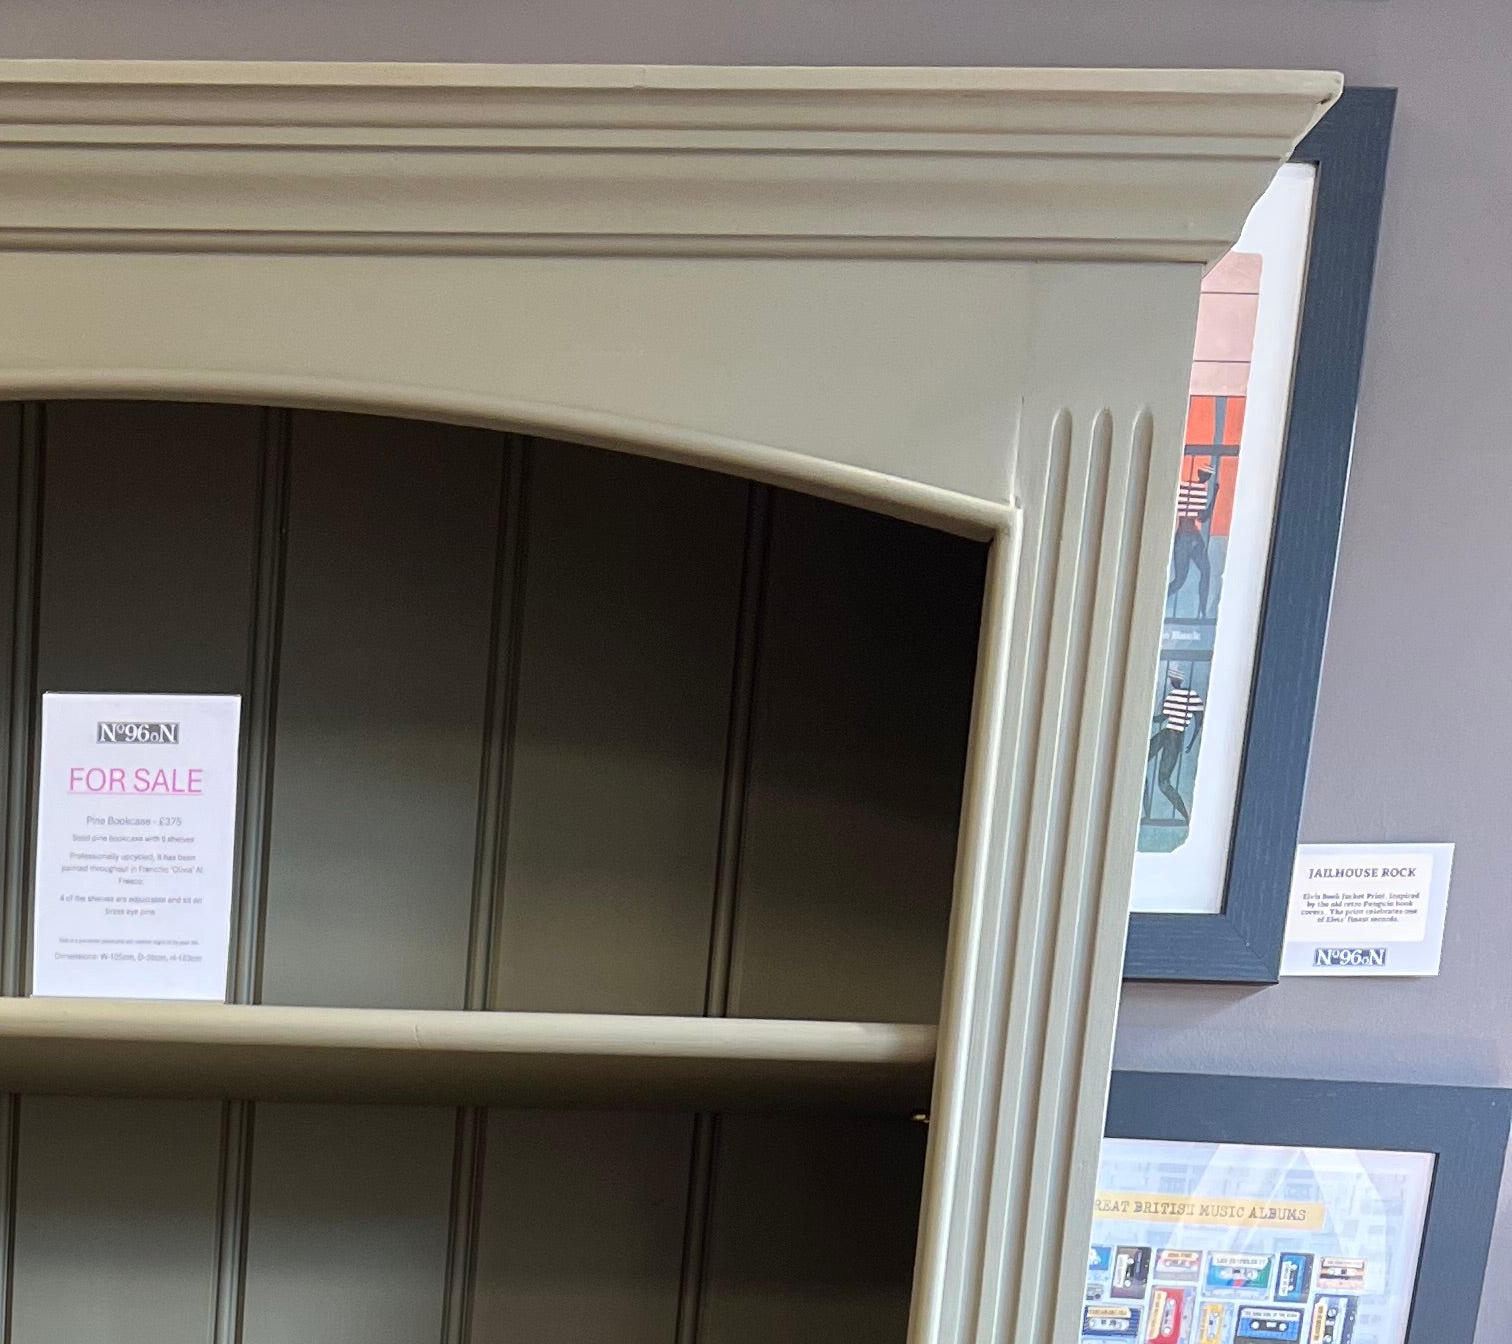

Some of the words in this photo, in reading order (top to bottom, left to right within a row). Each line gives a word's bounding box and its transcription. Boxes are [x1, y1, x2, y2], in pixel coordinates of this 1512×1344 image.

[69, 767, 127, 793] FOR
[133, 768, 204, 793] SALE
[1308, 867, 1379, 879] JAILHOUSE
[1381, 867, 1417, 878] ROCK
[1095, 1200, 1131, 1213] REAT
[1132, 1201, 1196, 1215] BRITISH
[1198, 1204, 1244, 1218] MUSIC
[1247, 1205, 1307, 1221] ALBUMS
